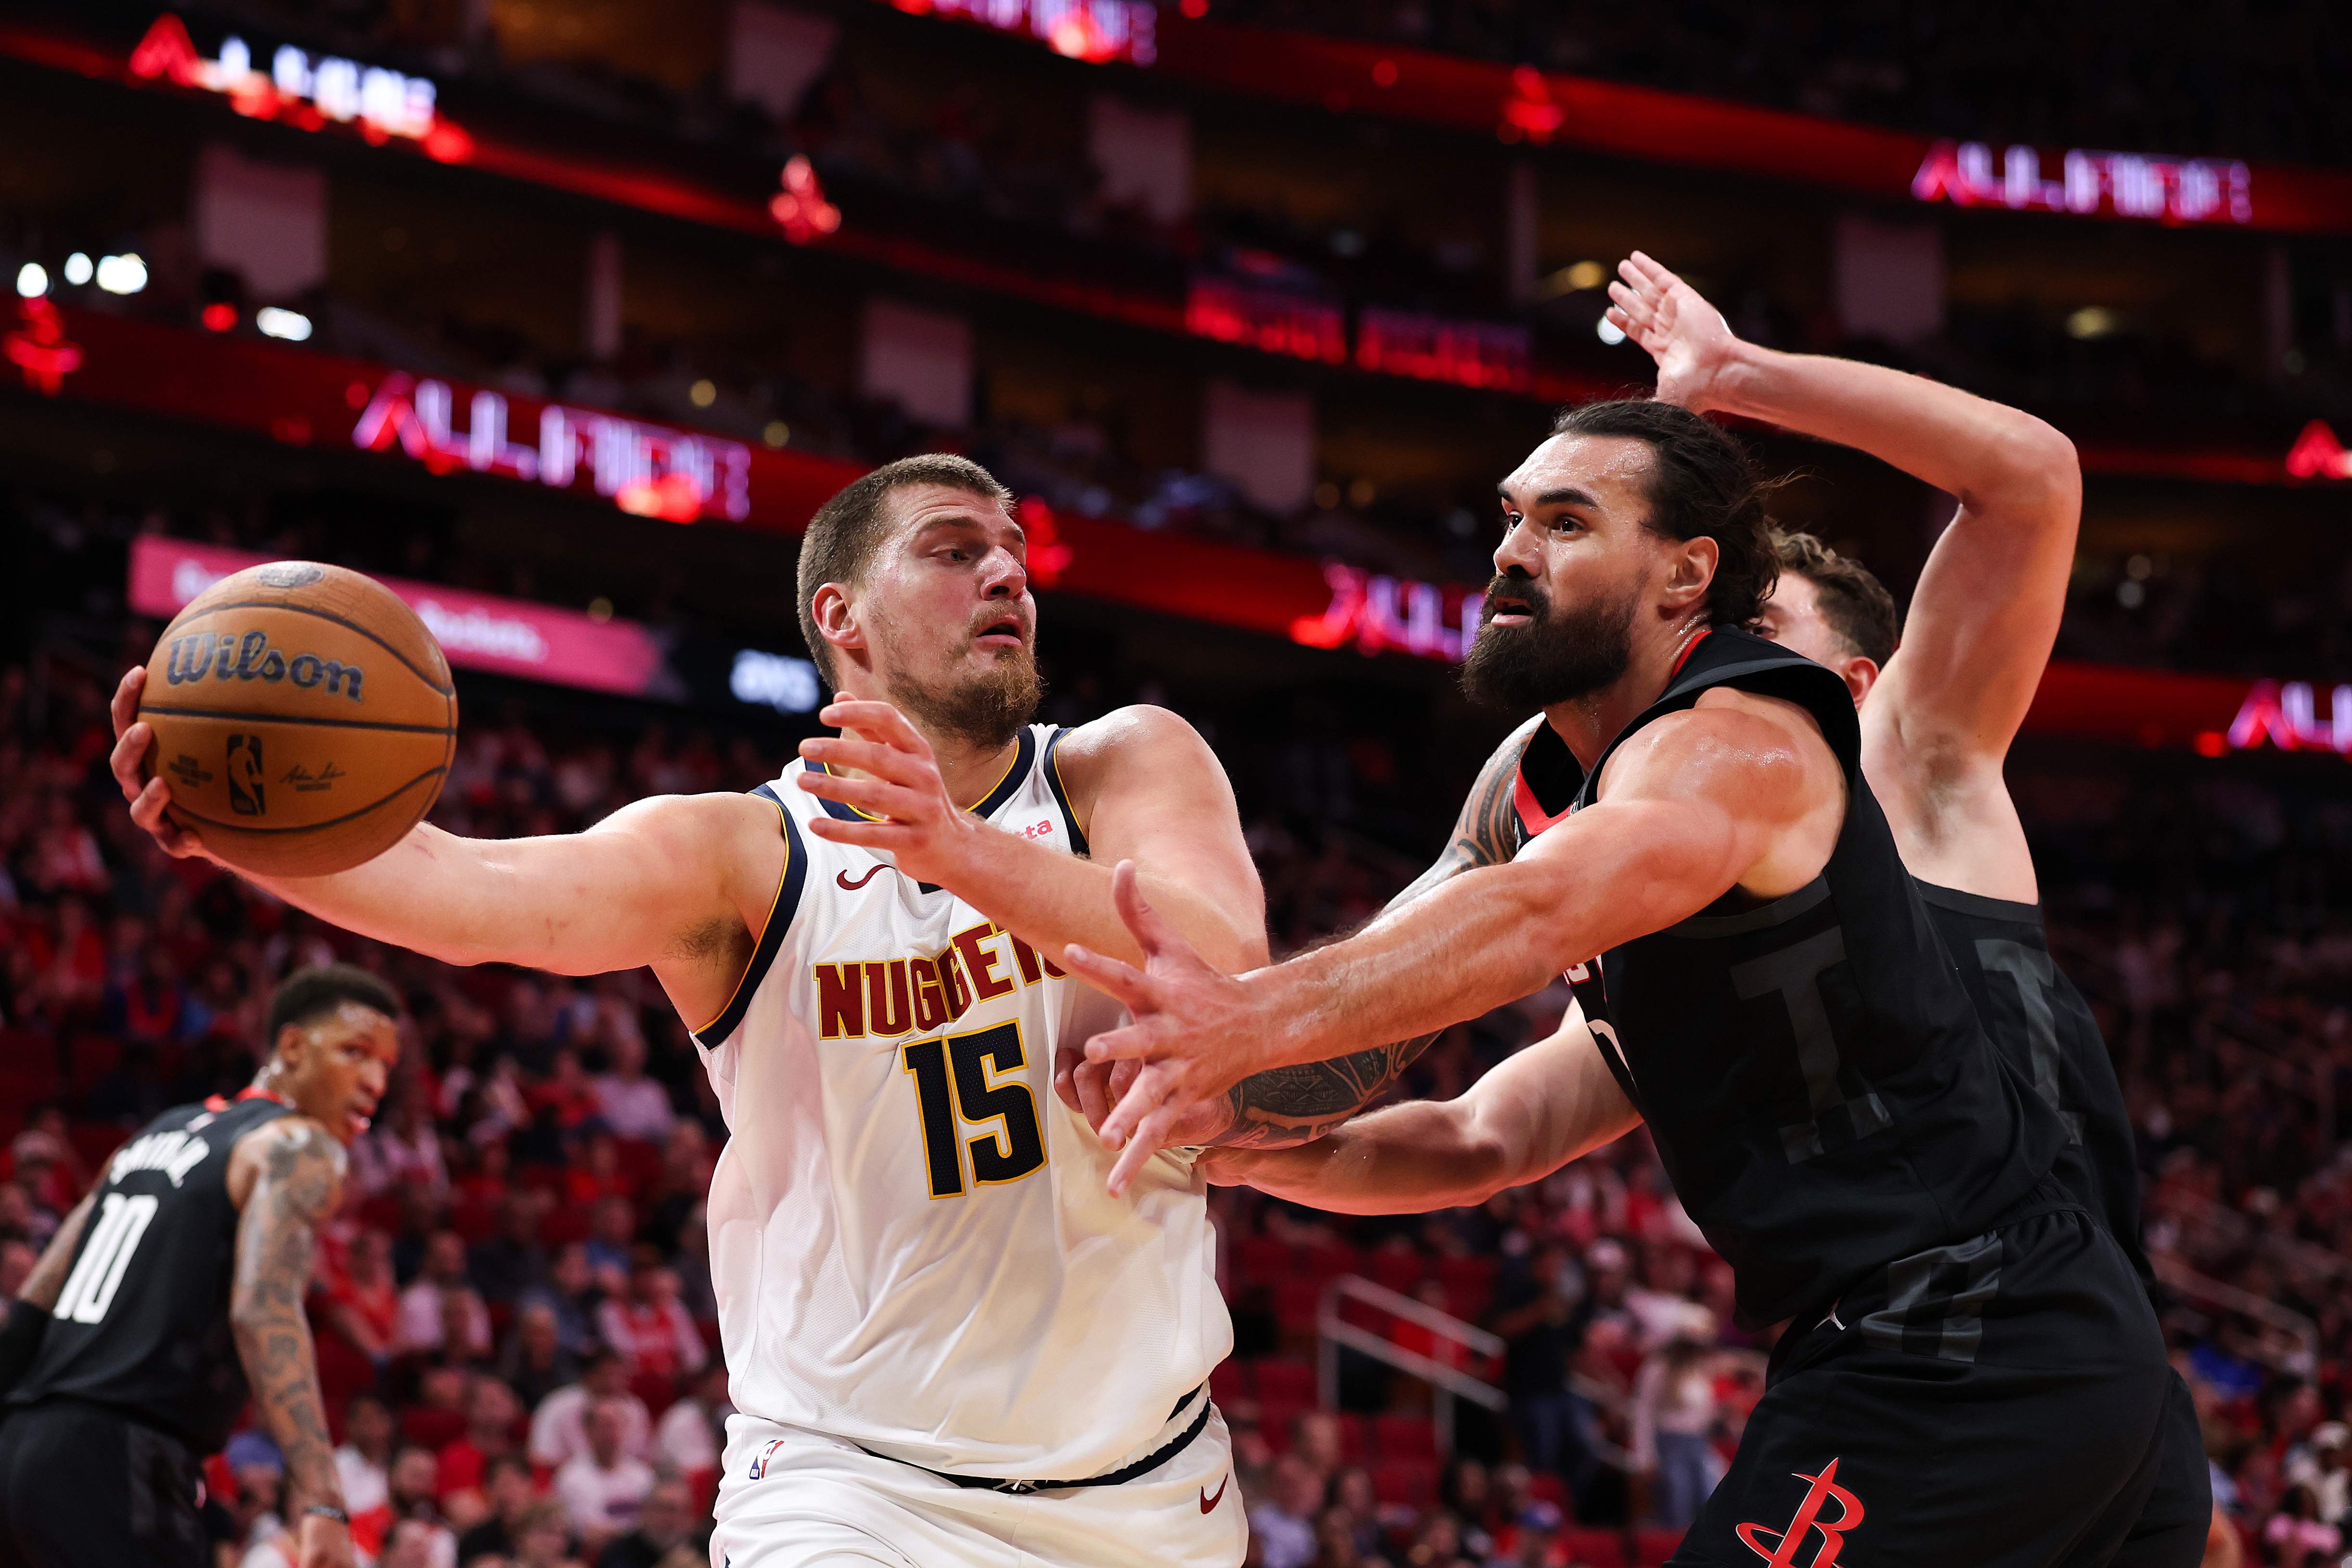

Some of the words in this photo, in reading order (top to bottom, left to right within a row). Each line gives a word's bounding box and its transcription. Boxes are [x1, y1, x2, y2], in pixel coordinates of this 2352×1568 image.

[167, 630, 364, 703] Wilson
[901, 1018, 1048, 1200] 15
[53, 1192, 158, 1324] 10
